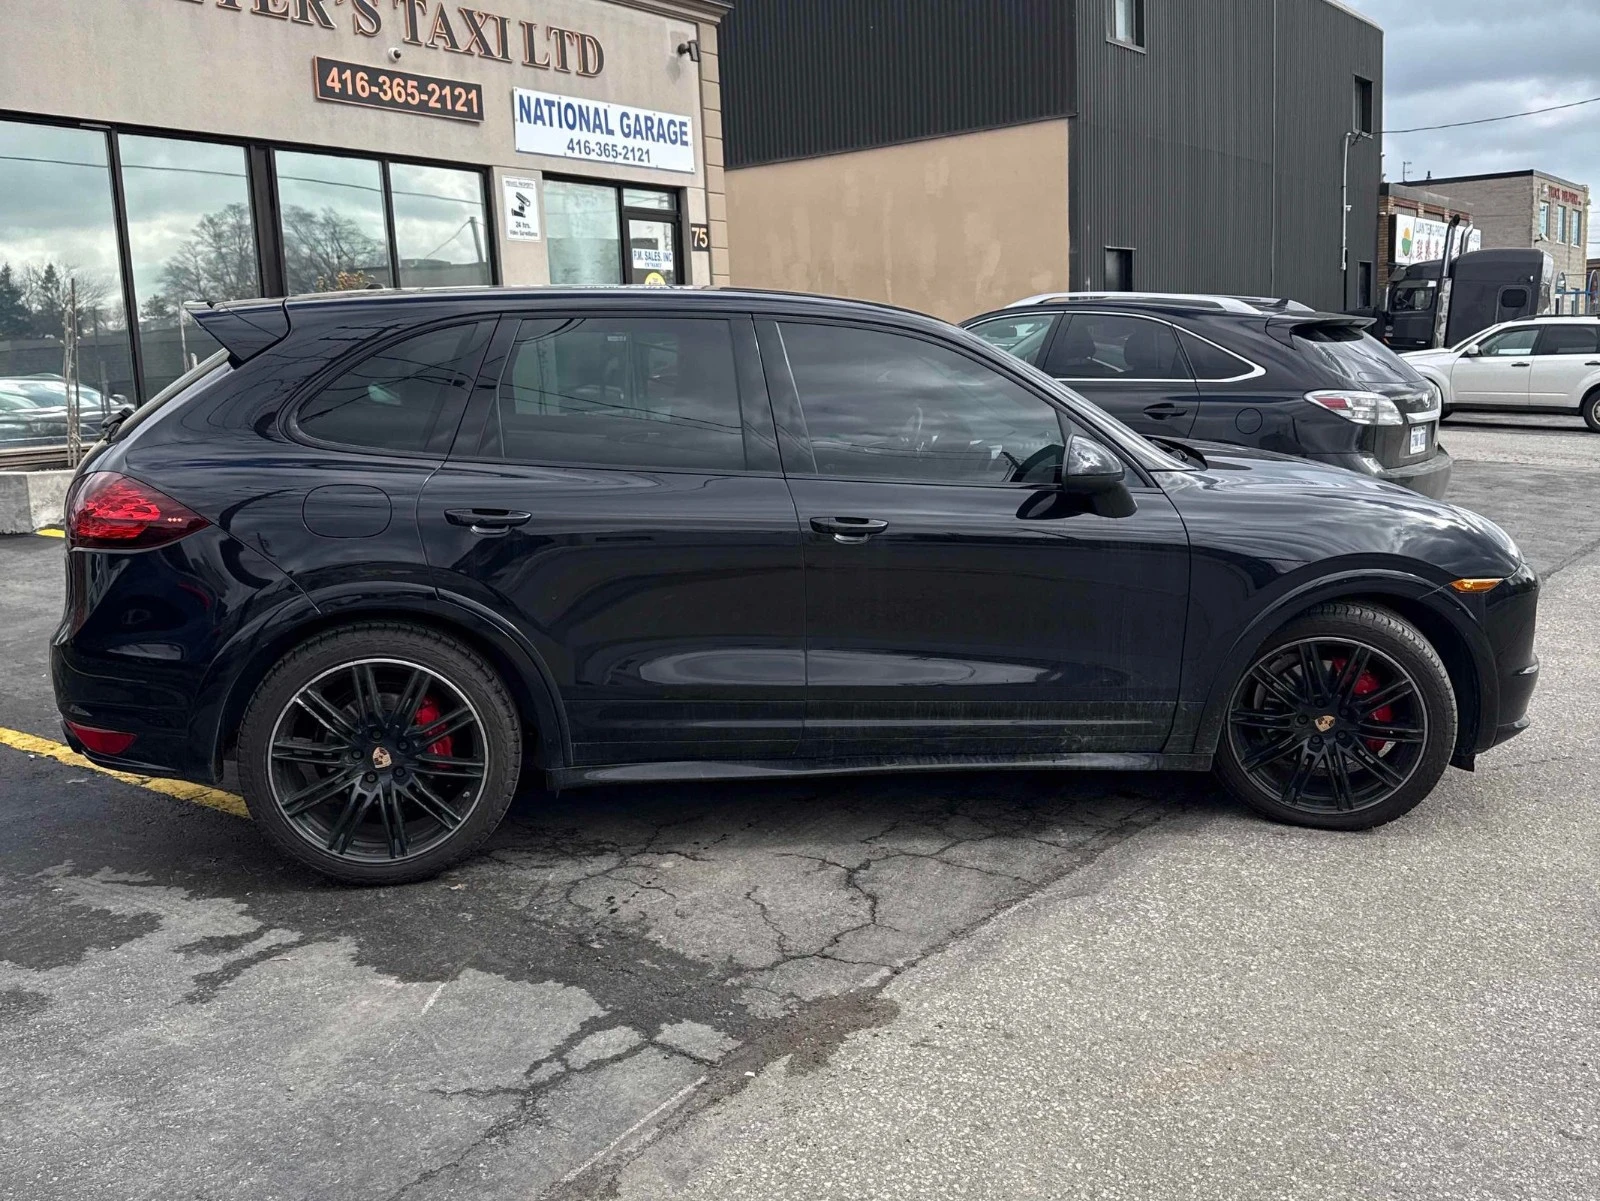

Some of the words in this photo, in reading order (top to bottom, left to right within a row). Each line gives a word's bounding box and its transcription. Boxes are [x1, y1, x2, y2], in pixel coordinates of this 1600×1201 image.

[393, 0, 512, 63] TAXI
[519, 20, 605, 77] LTD
[326, 66, 479, 114] 416-365-2121
[518, 94, 615, 136] NATIONAL
[619, 111, 689, 147] GARAGE
[566, 137, 651, 164] 416-365-2121
[691, 226, 708, 248] 75
